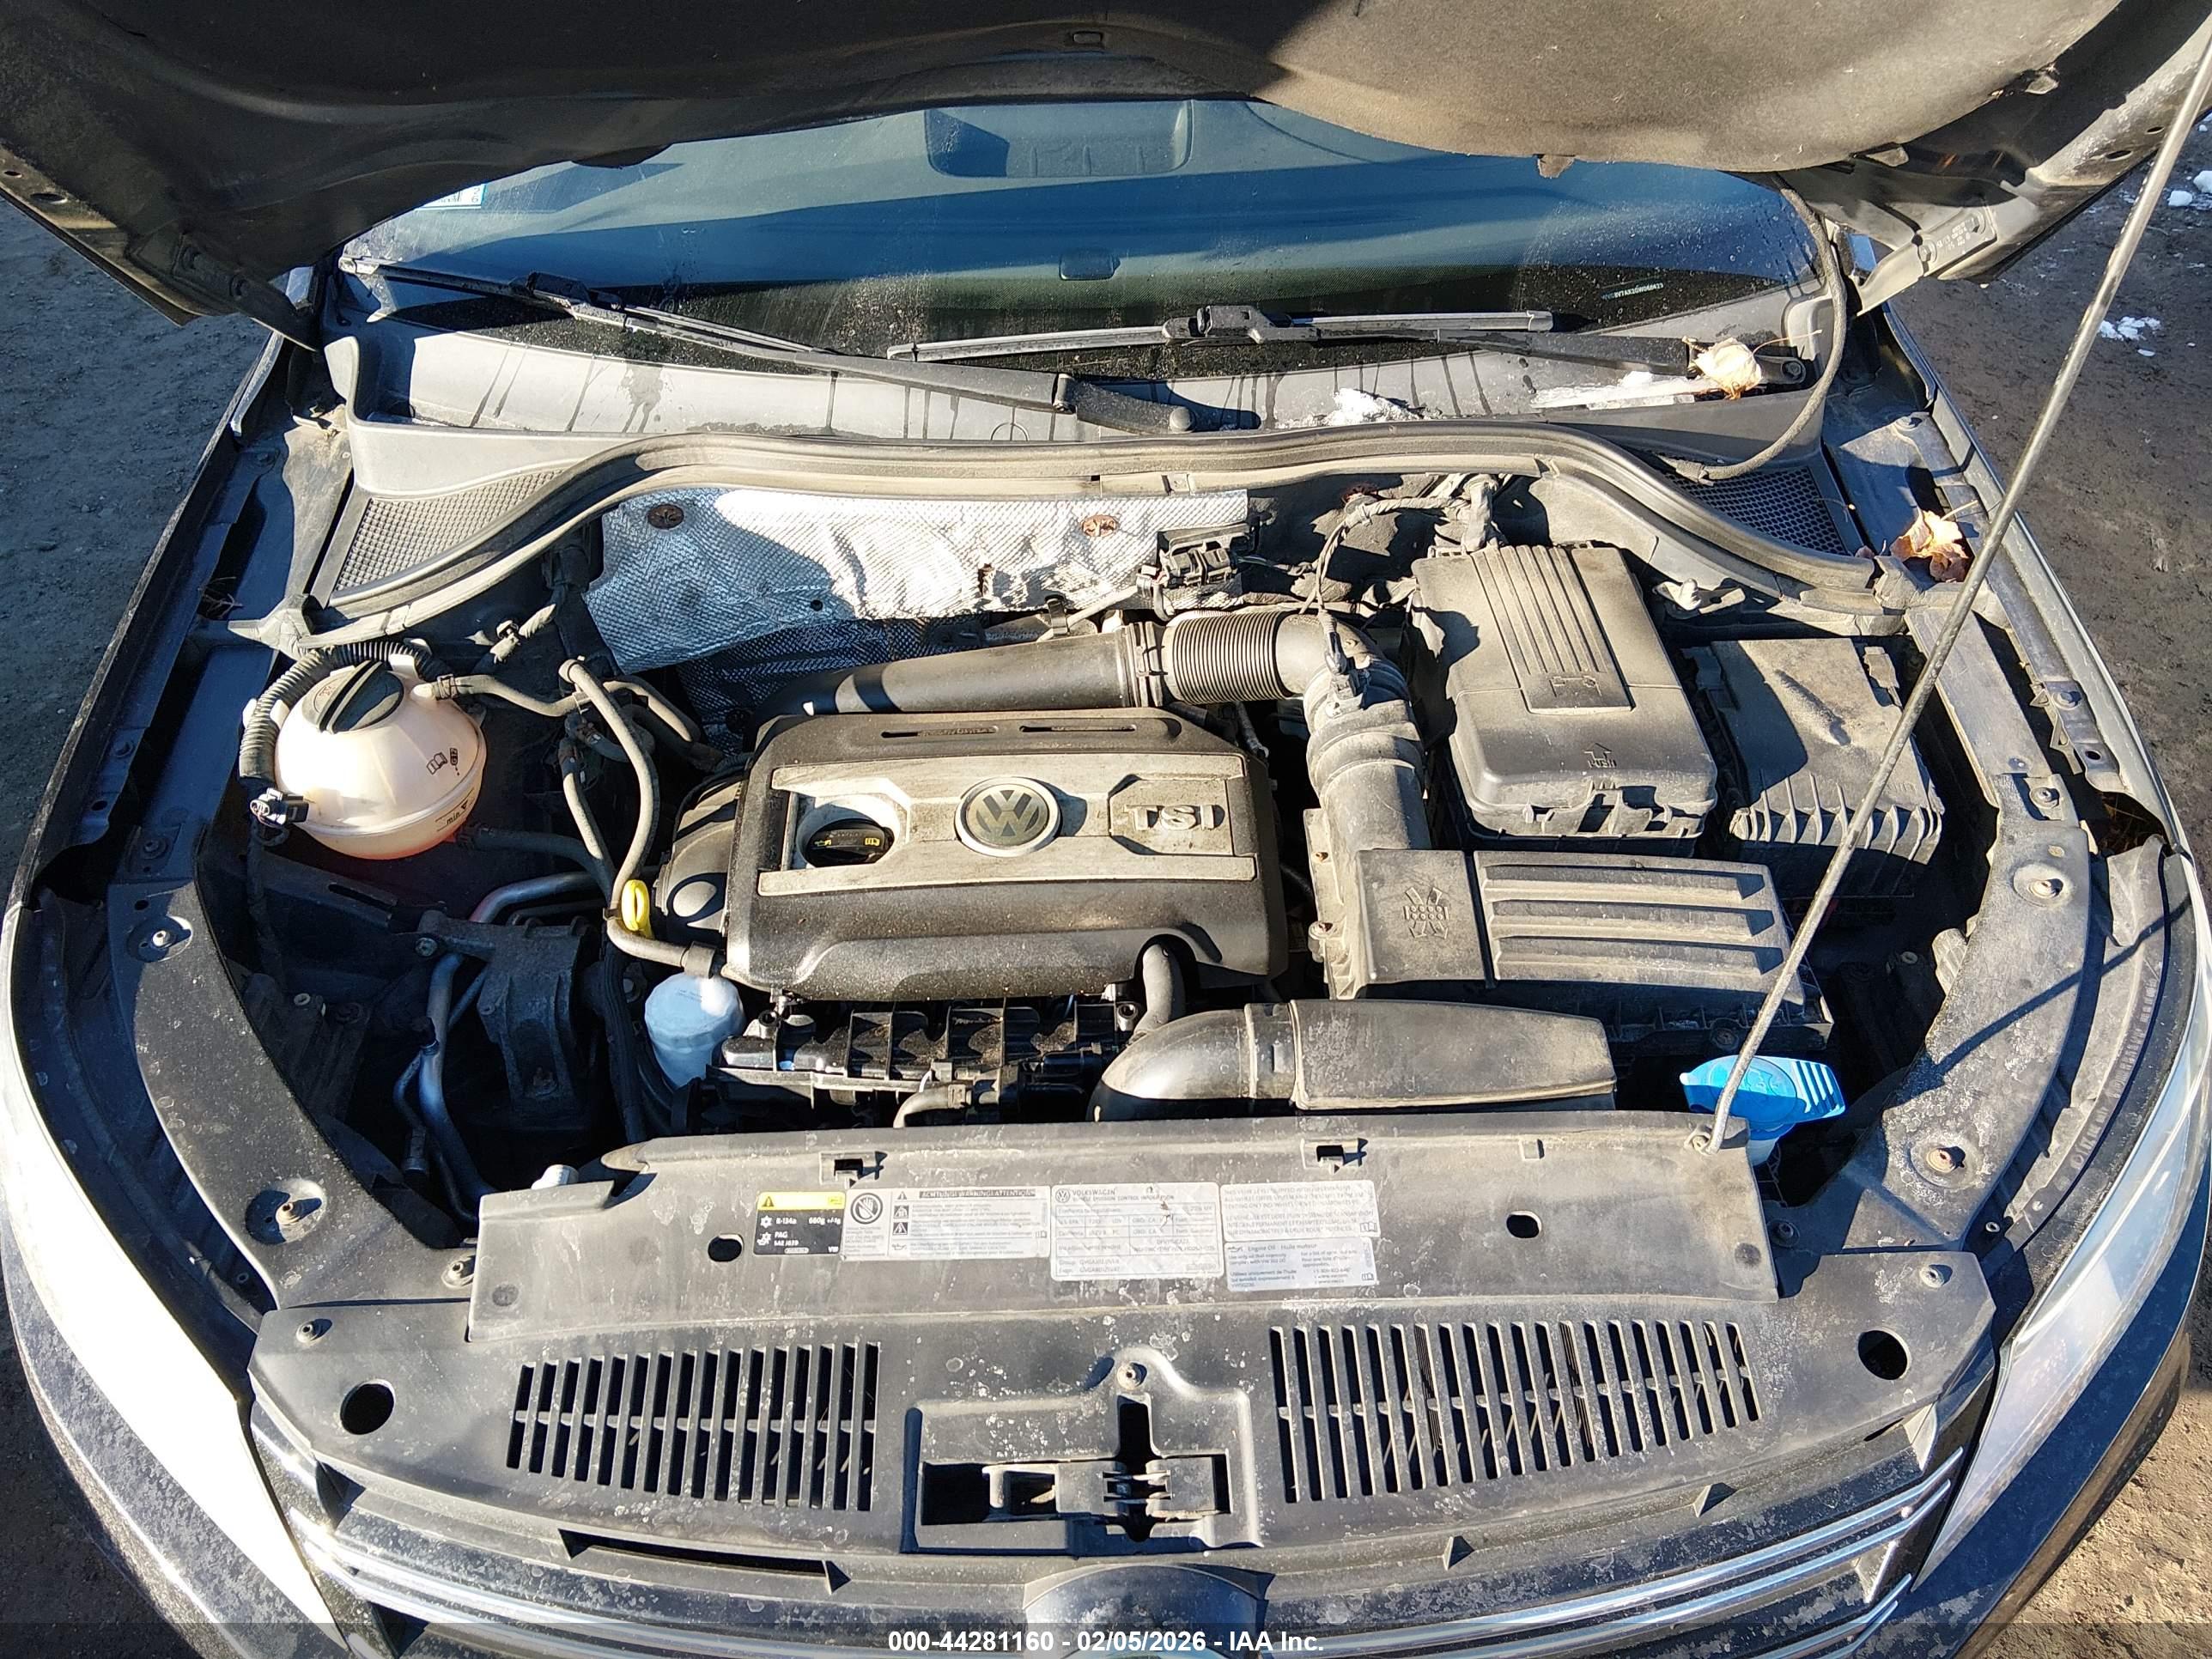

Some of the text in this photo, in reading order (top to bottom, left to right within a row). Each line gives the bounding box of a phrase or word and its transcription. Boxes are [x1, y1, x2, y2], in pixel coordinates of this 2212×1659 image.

[1587, 759, 1617, 769] PUSH
[446, 811, 461, 825] min
[1124, 804, 1216, 830] TSI
